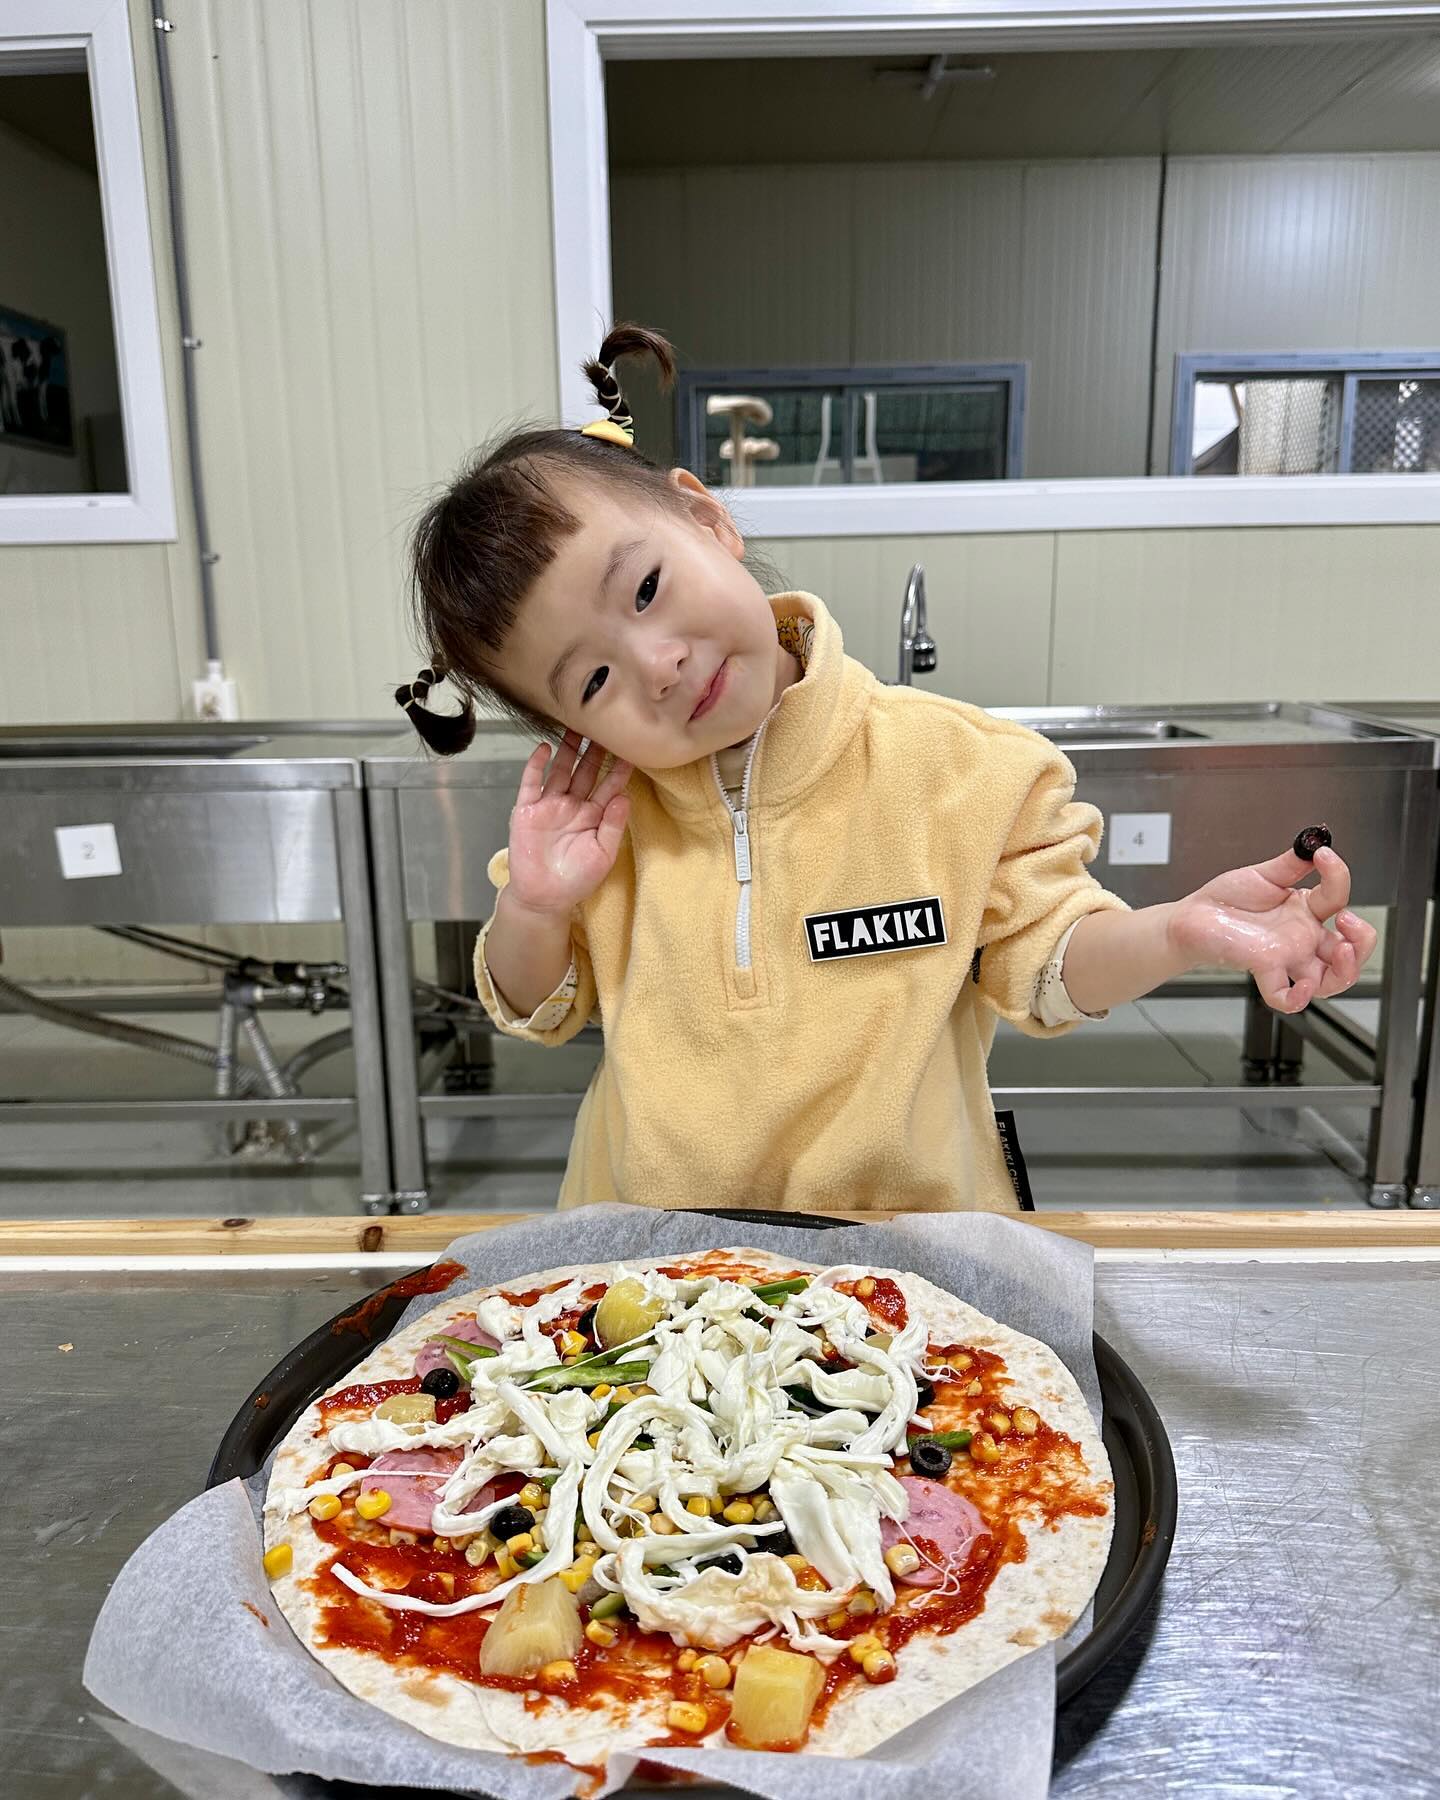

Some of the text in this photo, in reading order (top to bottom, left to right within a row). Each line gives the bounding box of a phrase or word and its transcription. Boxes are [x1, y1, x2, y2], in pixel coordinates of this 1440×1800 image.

[1132, 830, 1145, 847] 4
[81, 841, 95, 860] 2
[813, 907, 937, 953] FLAKIKI
